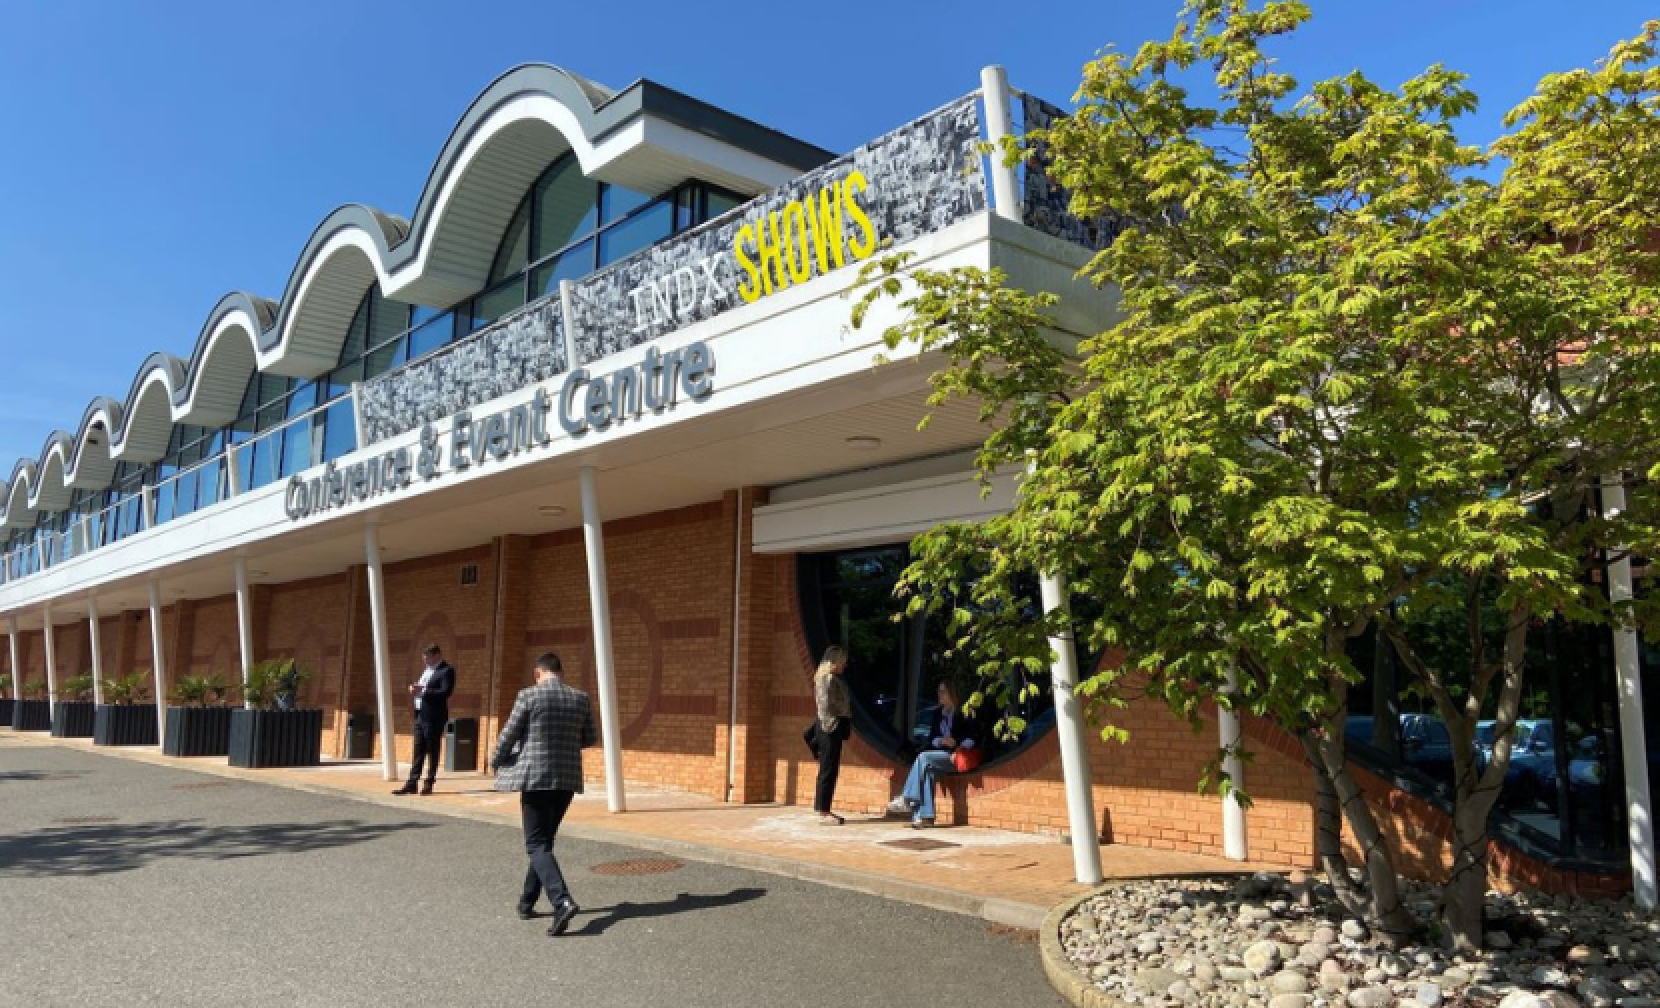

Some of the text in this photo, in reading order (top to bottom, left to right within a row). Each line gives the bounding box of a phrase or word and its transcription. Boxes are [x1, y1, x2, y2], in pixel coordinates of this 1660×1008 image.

[628, 170, 876, 332] INDX SHOWS
[284, 340, 717, 521] Conference & Event Centre
